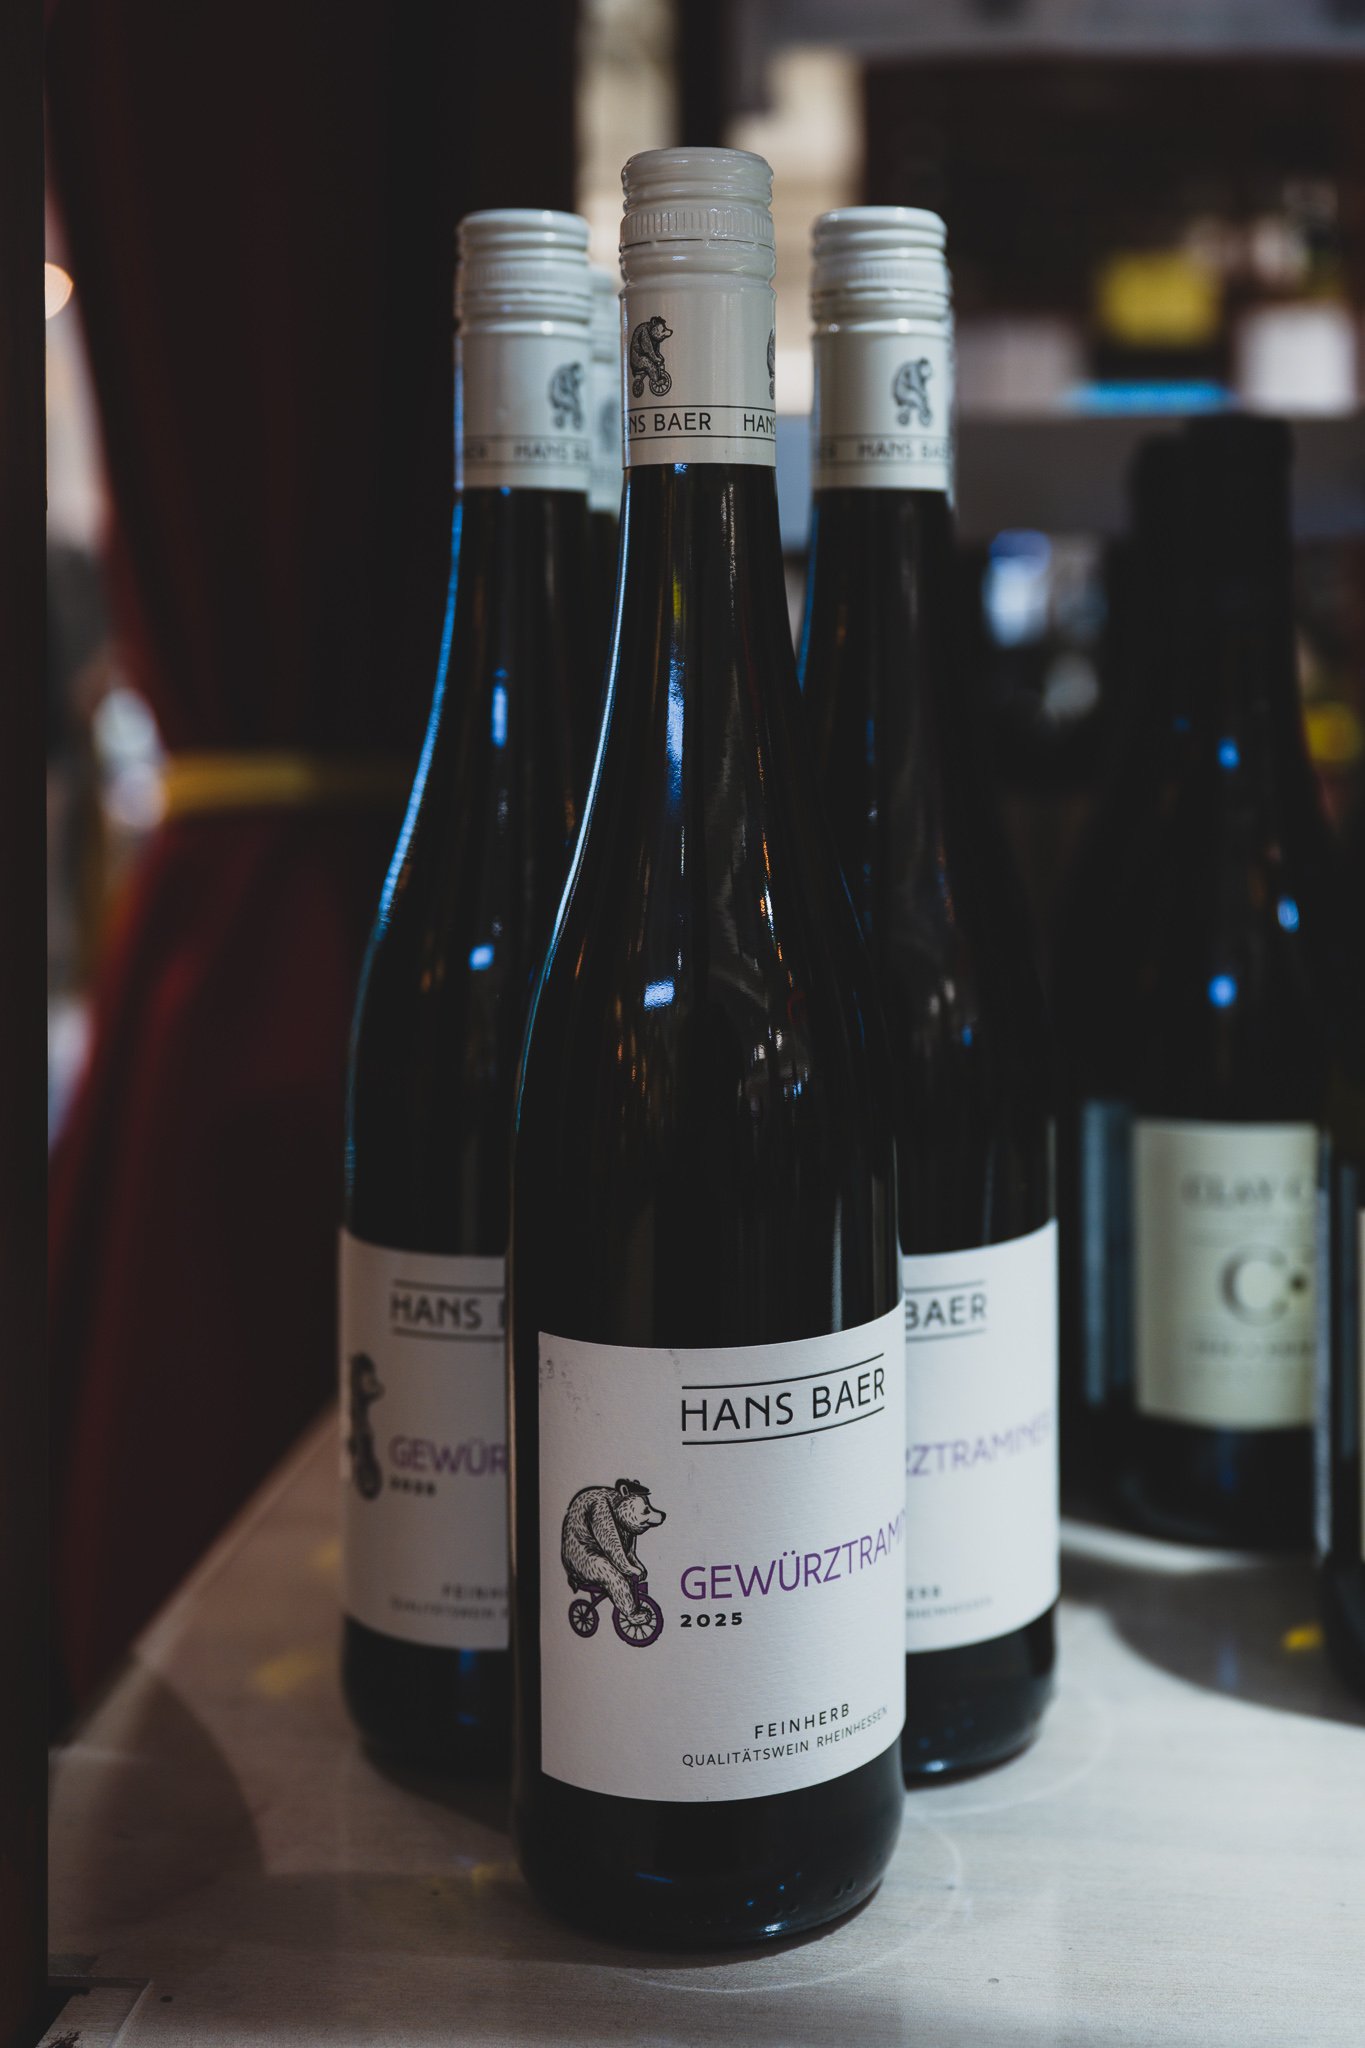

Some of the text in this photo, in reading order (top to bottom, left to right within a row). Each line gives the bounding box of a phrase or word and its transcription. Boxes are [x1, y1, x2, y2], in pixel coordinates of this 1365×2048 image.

[654, 412, 711, 432] BAER
[391, 1295, 483, 1331] HANS
[681, 1367, 886, 1432] HANS BAER
[680, 1612, 743, 1628] 2025
[682, 1704, 889, 1768] QUALITÄTSWEIN RHEINHESSEN
[754, 1703, 851, 1740] FEINHERB
